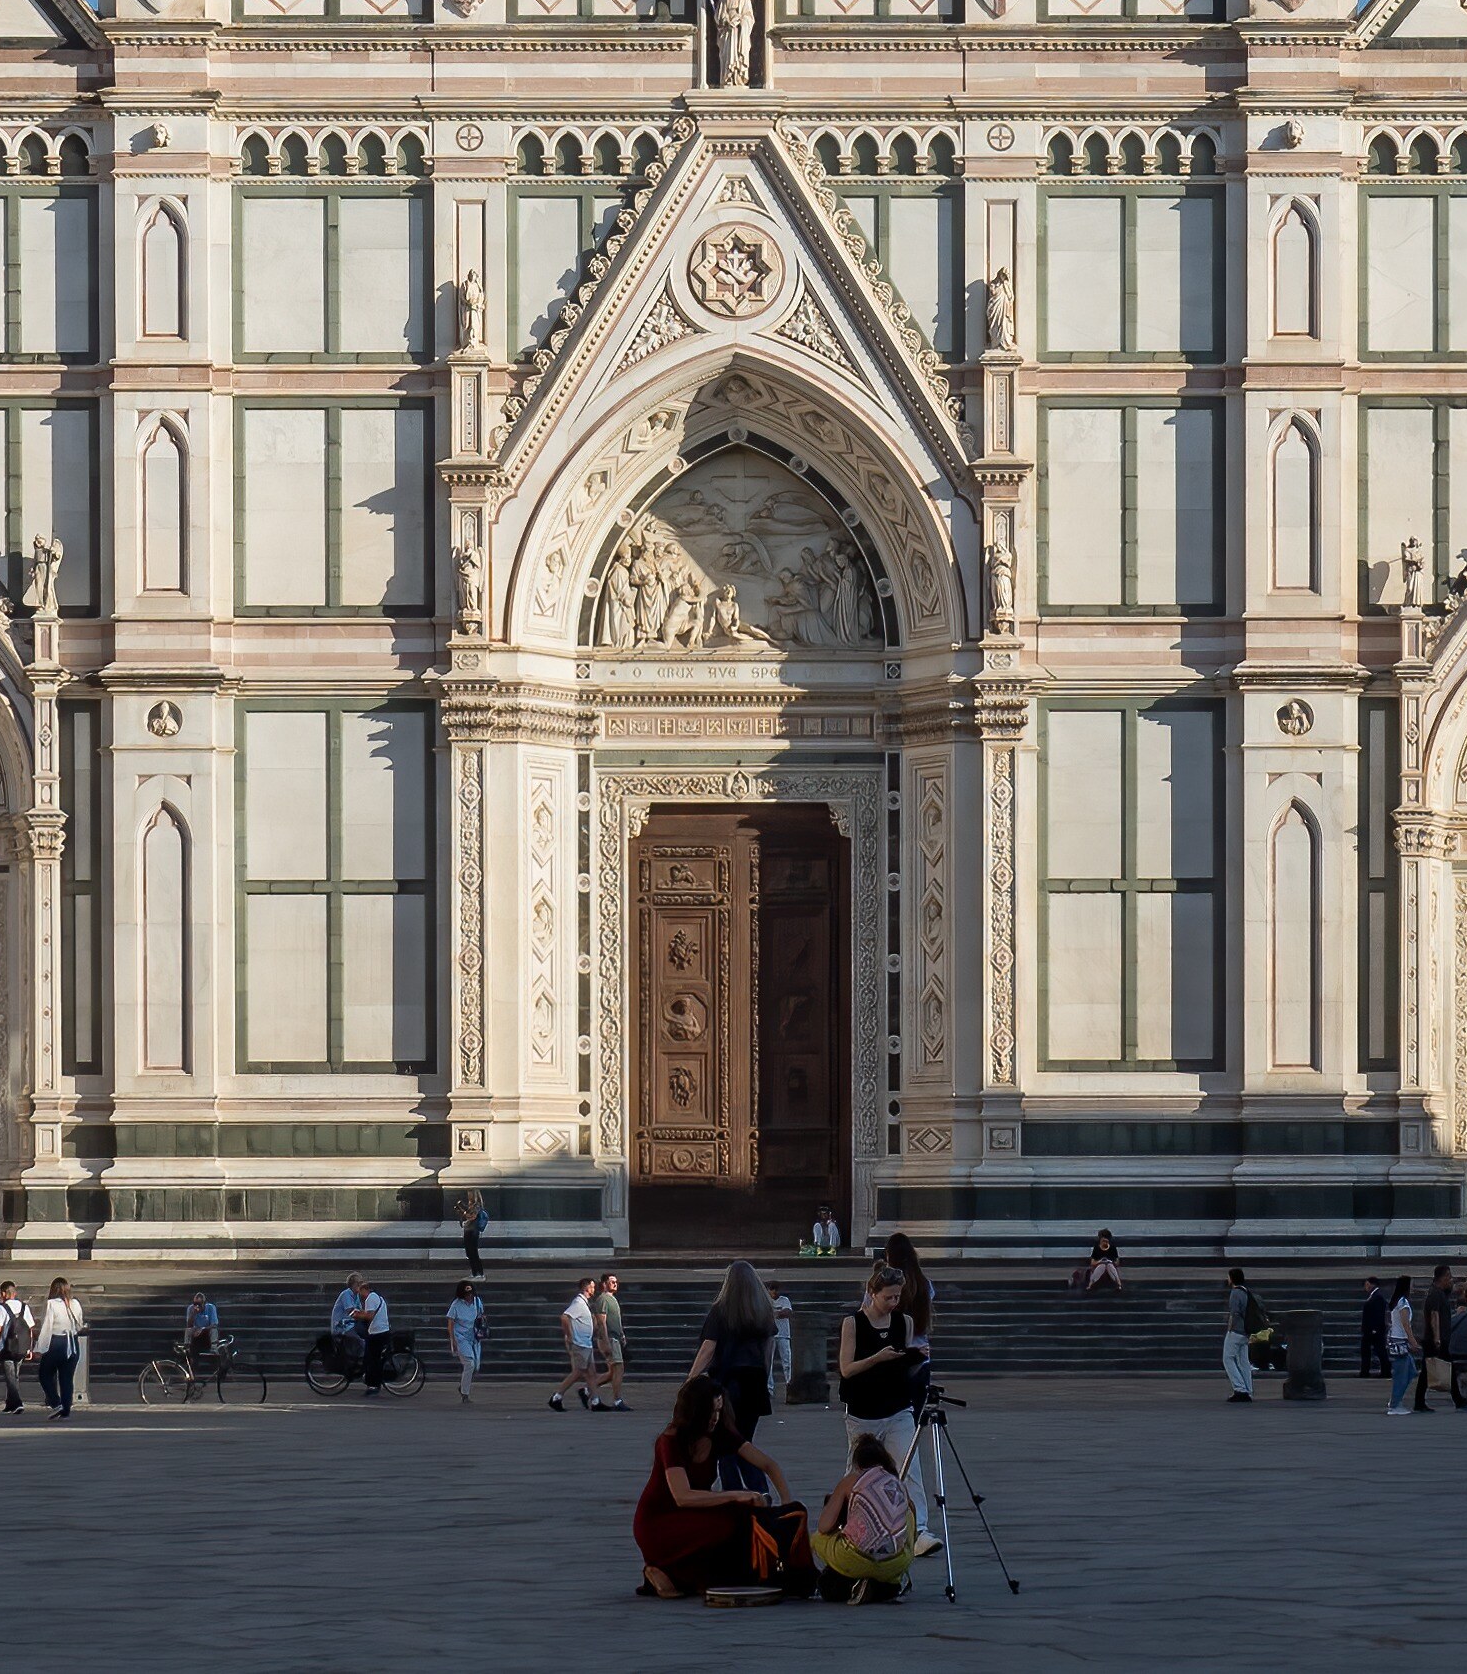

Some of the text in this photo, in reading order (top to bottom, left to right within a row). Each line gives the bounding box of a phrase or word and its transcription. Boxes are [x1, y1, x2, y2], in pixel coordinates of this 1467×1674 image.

[632, 667, 642, 679] O
[657, 666, 694, 679] CRUX
[708, 666, 737, 679] AVE
